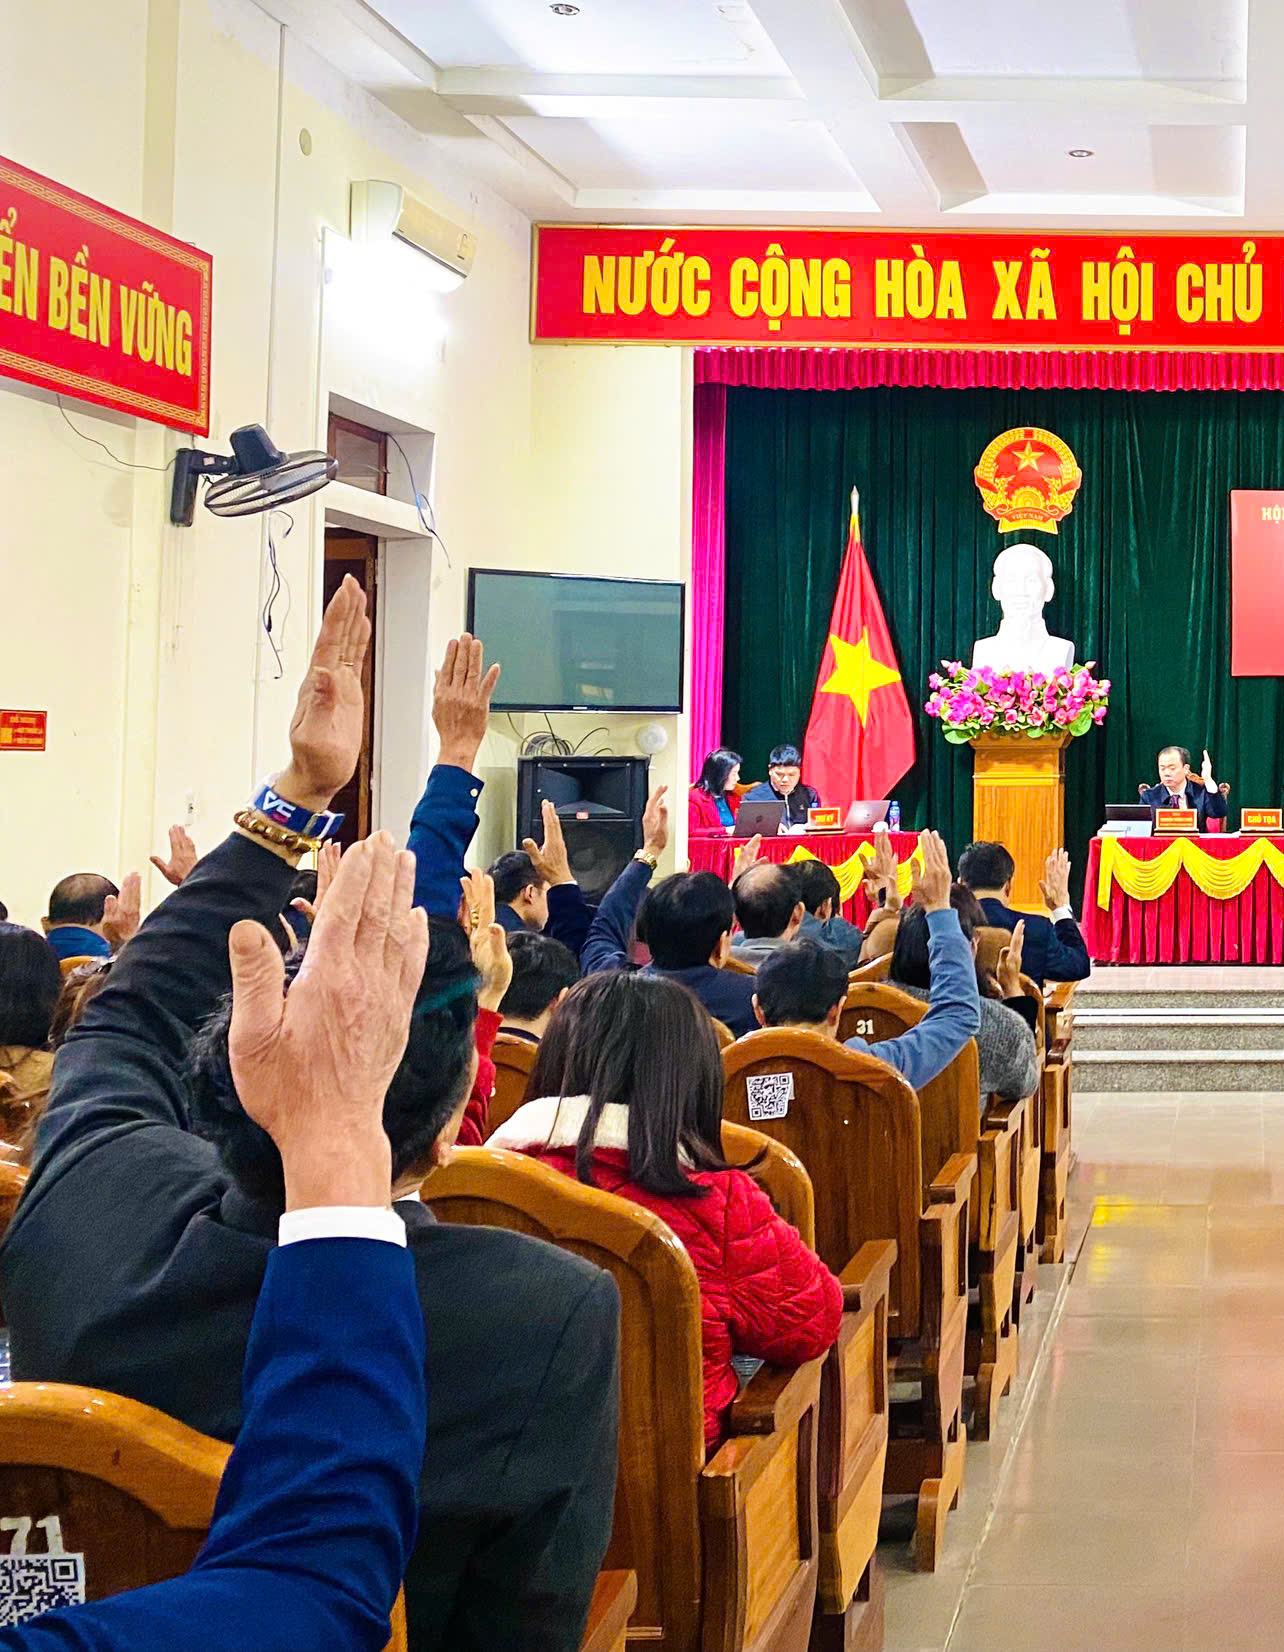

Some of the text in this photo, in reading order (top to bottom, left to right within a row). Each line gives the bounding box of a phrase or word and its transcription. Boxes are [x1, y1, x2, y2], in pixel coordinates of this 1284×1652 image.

[48, 244, 111, 348] BỀN
[120, 280, 193, 377] VỮNG
[583, 238, 711, 315] NƯỚC
[729, 243, 851, 331] CỘNG
[876, 245, 966, 319] HÒA
[992, 248, 1058, 319] XÃ
[1083, 245, 1154, 335] HỘI
[1176, 241, 1262, 322] CHỦ
[856, 1019, 874, 1035] 31
[0, 1515, 63, 1555] 71
